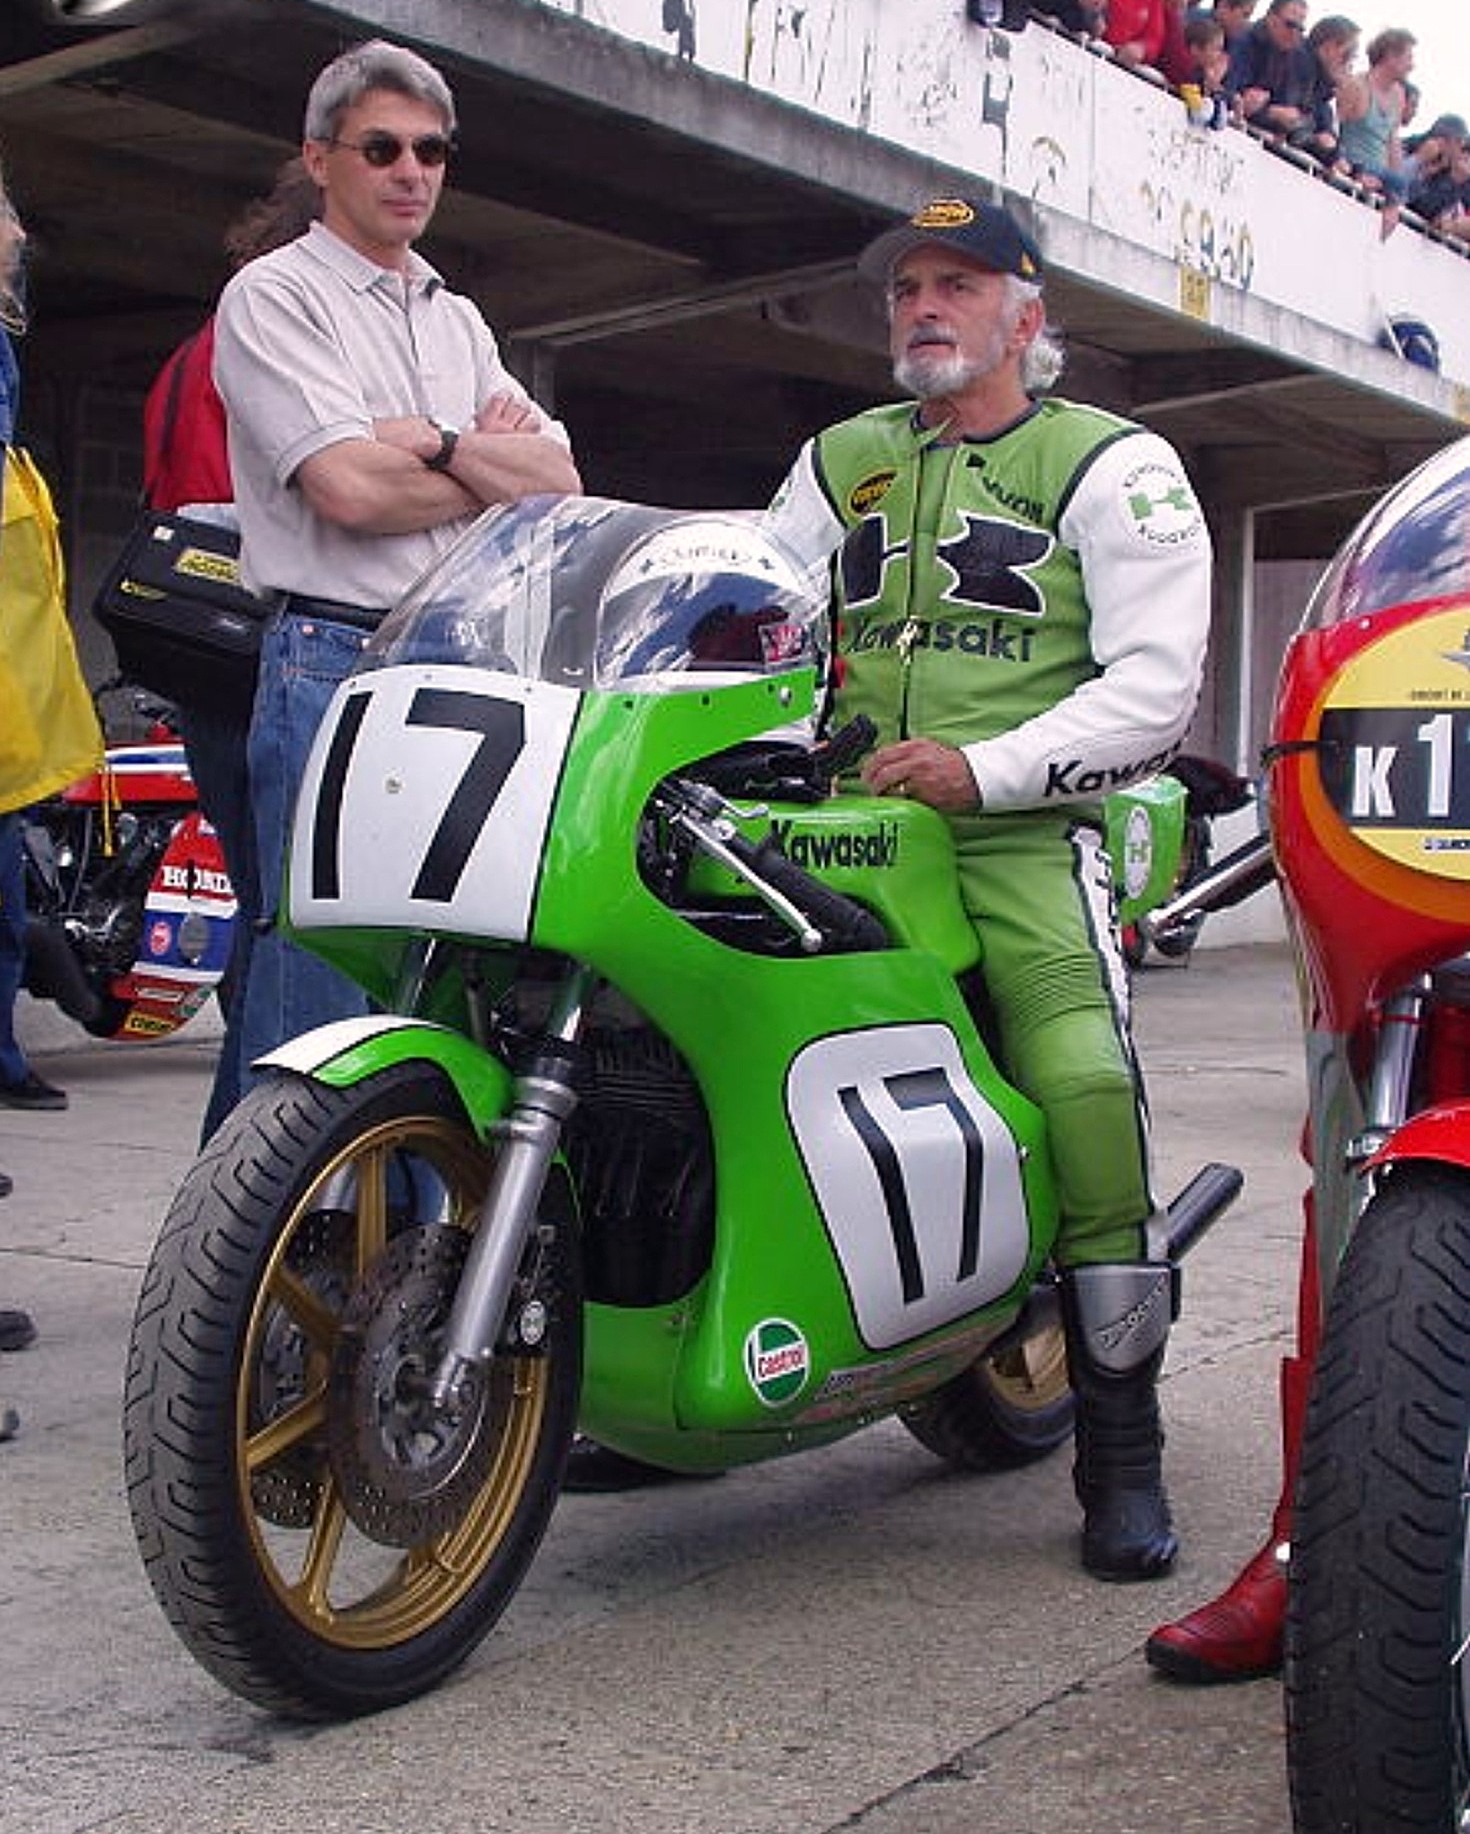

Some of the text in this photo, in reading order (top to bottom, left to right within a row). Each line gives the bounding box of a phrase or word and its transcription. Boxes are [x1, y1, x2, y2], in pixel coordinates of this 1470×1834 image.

[311, 687, 527, 903] 17
[1043, 742, 1181, 798] Kawa
[1352, 713, 1470, 818] K 1
[162, 865, 235, 893] HOND
[770, 819, 899, 869] Kawasaki
[836, 1066, 985, 1305] 17
